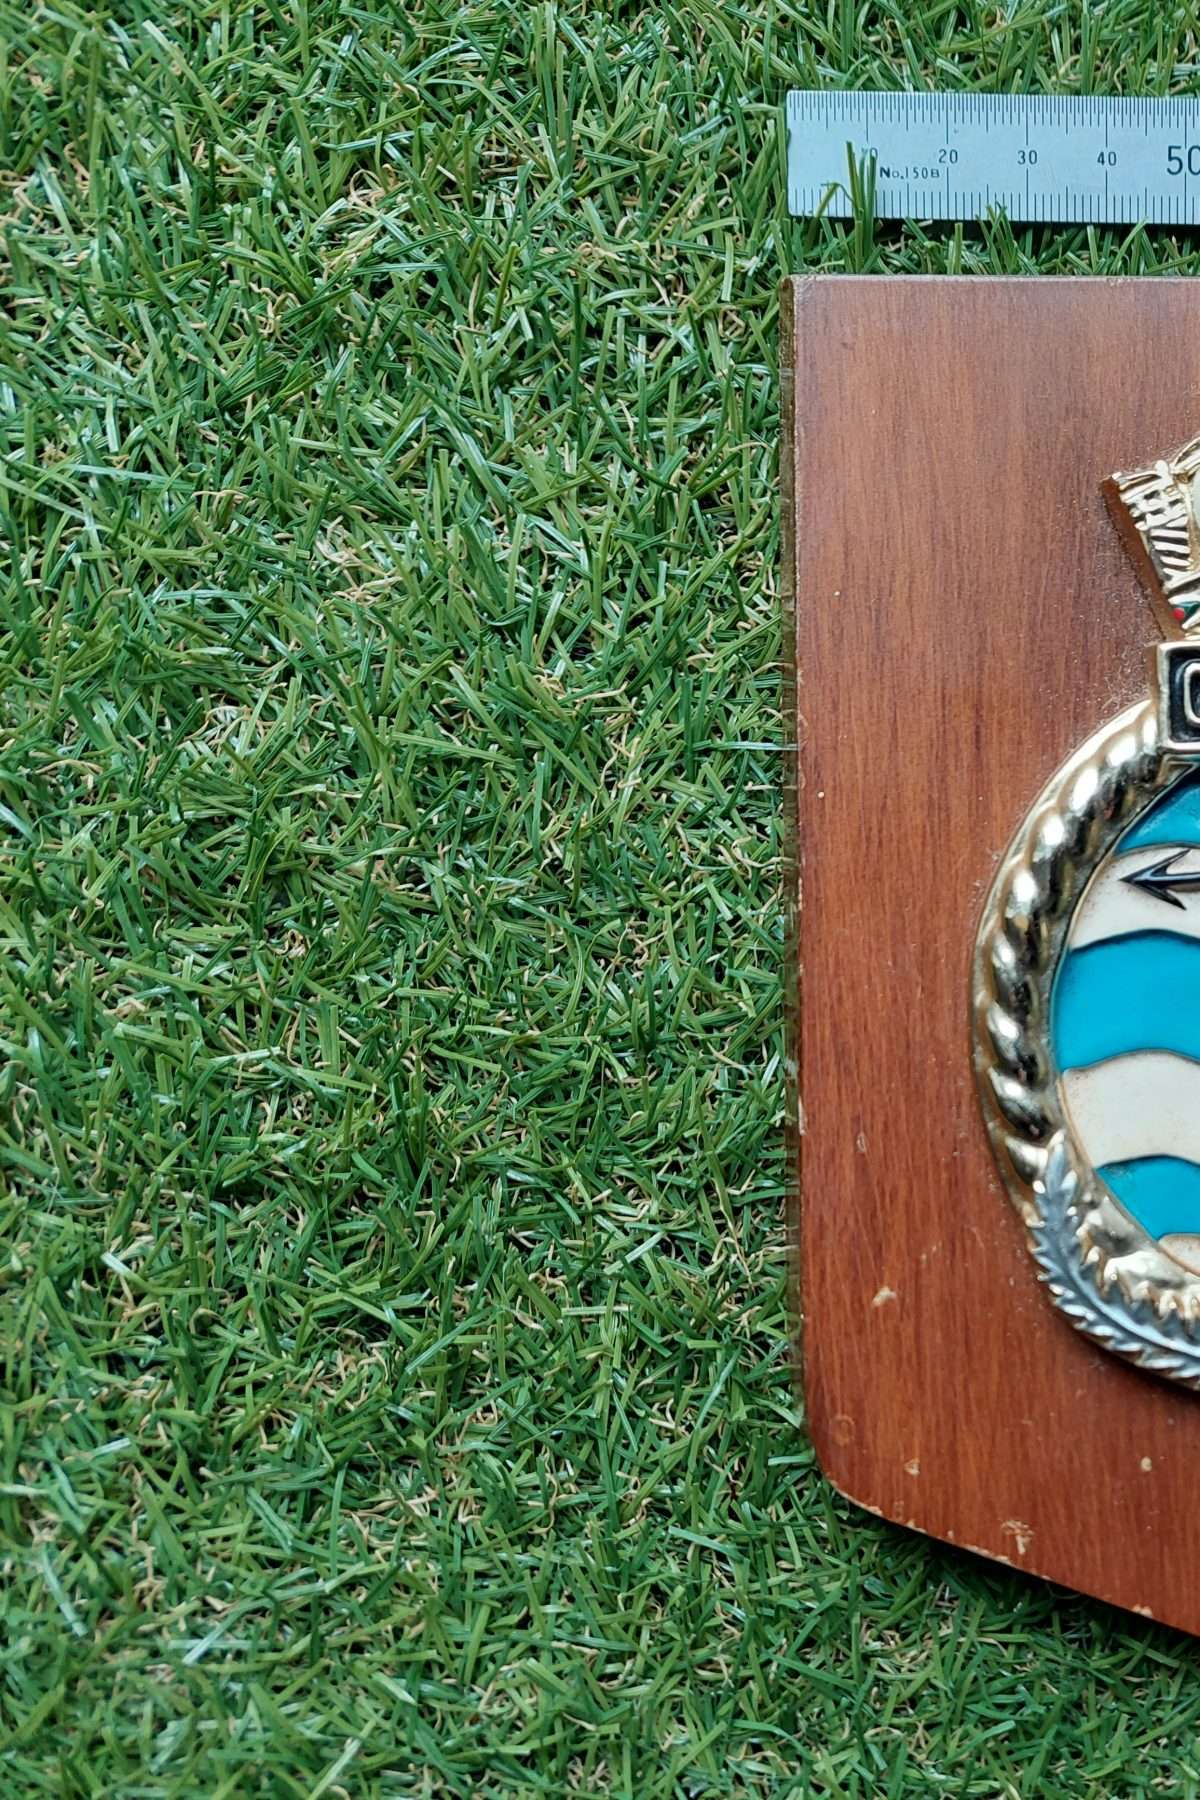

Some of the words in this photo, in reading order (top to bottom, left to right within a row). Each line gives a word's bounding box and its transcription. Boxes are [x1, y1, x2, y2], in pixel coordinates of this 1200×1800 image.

[938, 148, 958, 164] 20
[1017, 150, 1038, 165] 30
[1096, 151, 1117, 166] 40
